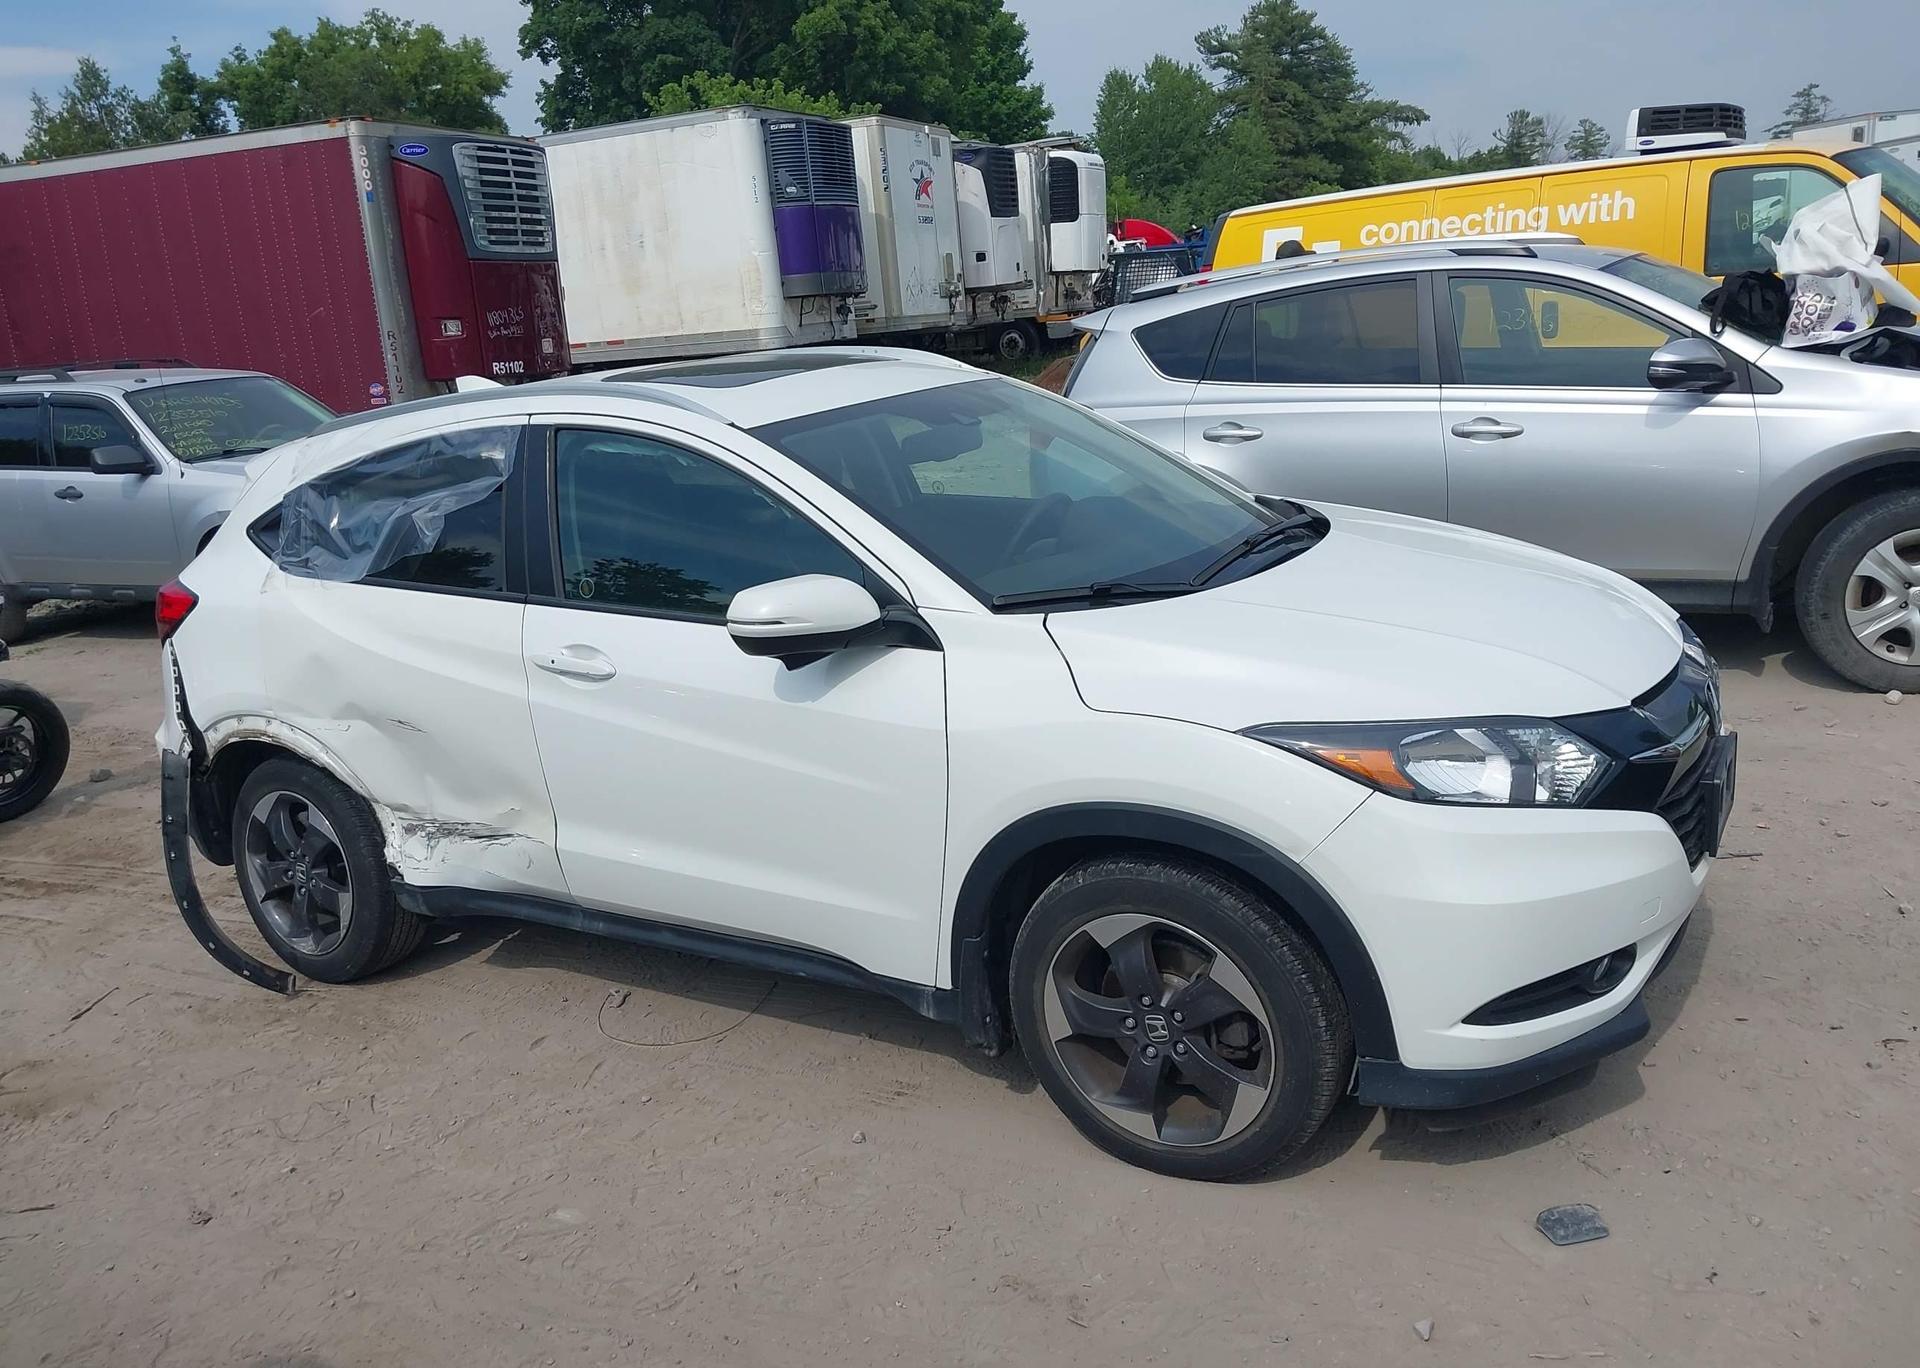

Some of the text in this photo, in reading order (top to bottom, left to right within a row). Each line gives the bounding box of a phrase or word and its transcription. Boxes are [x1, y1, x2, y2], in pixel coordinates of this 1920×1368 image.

[359, 145, 373, 191] 3000
[401, 146, 426, 154] Carrier
[1360, 190, 1636, 247] connecting with
[387, 330, 406, 394] R51102
[492, 360, 525, 375] R51102
